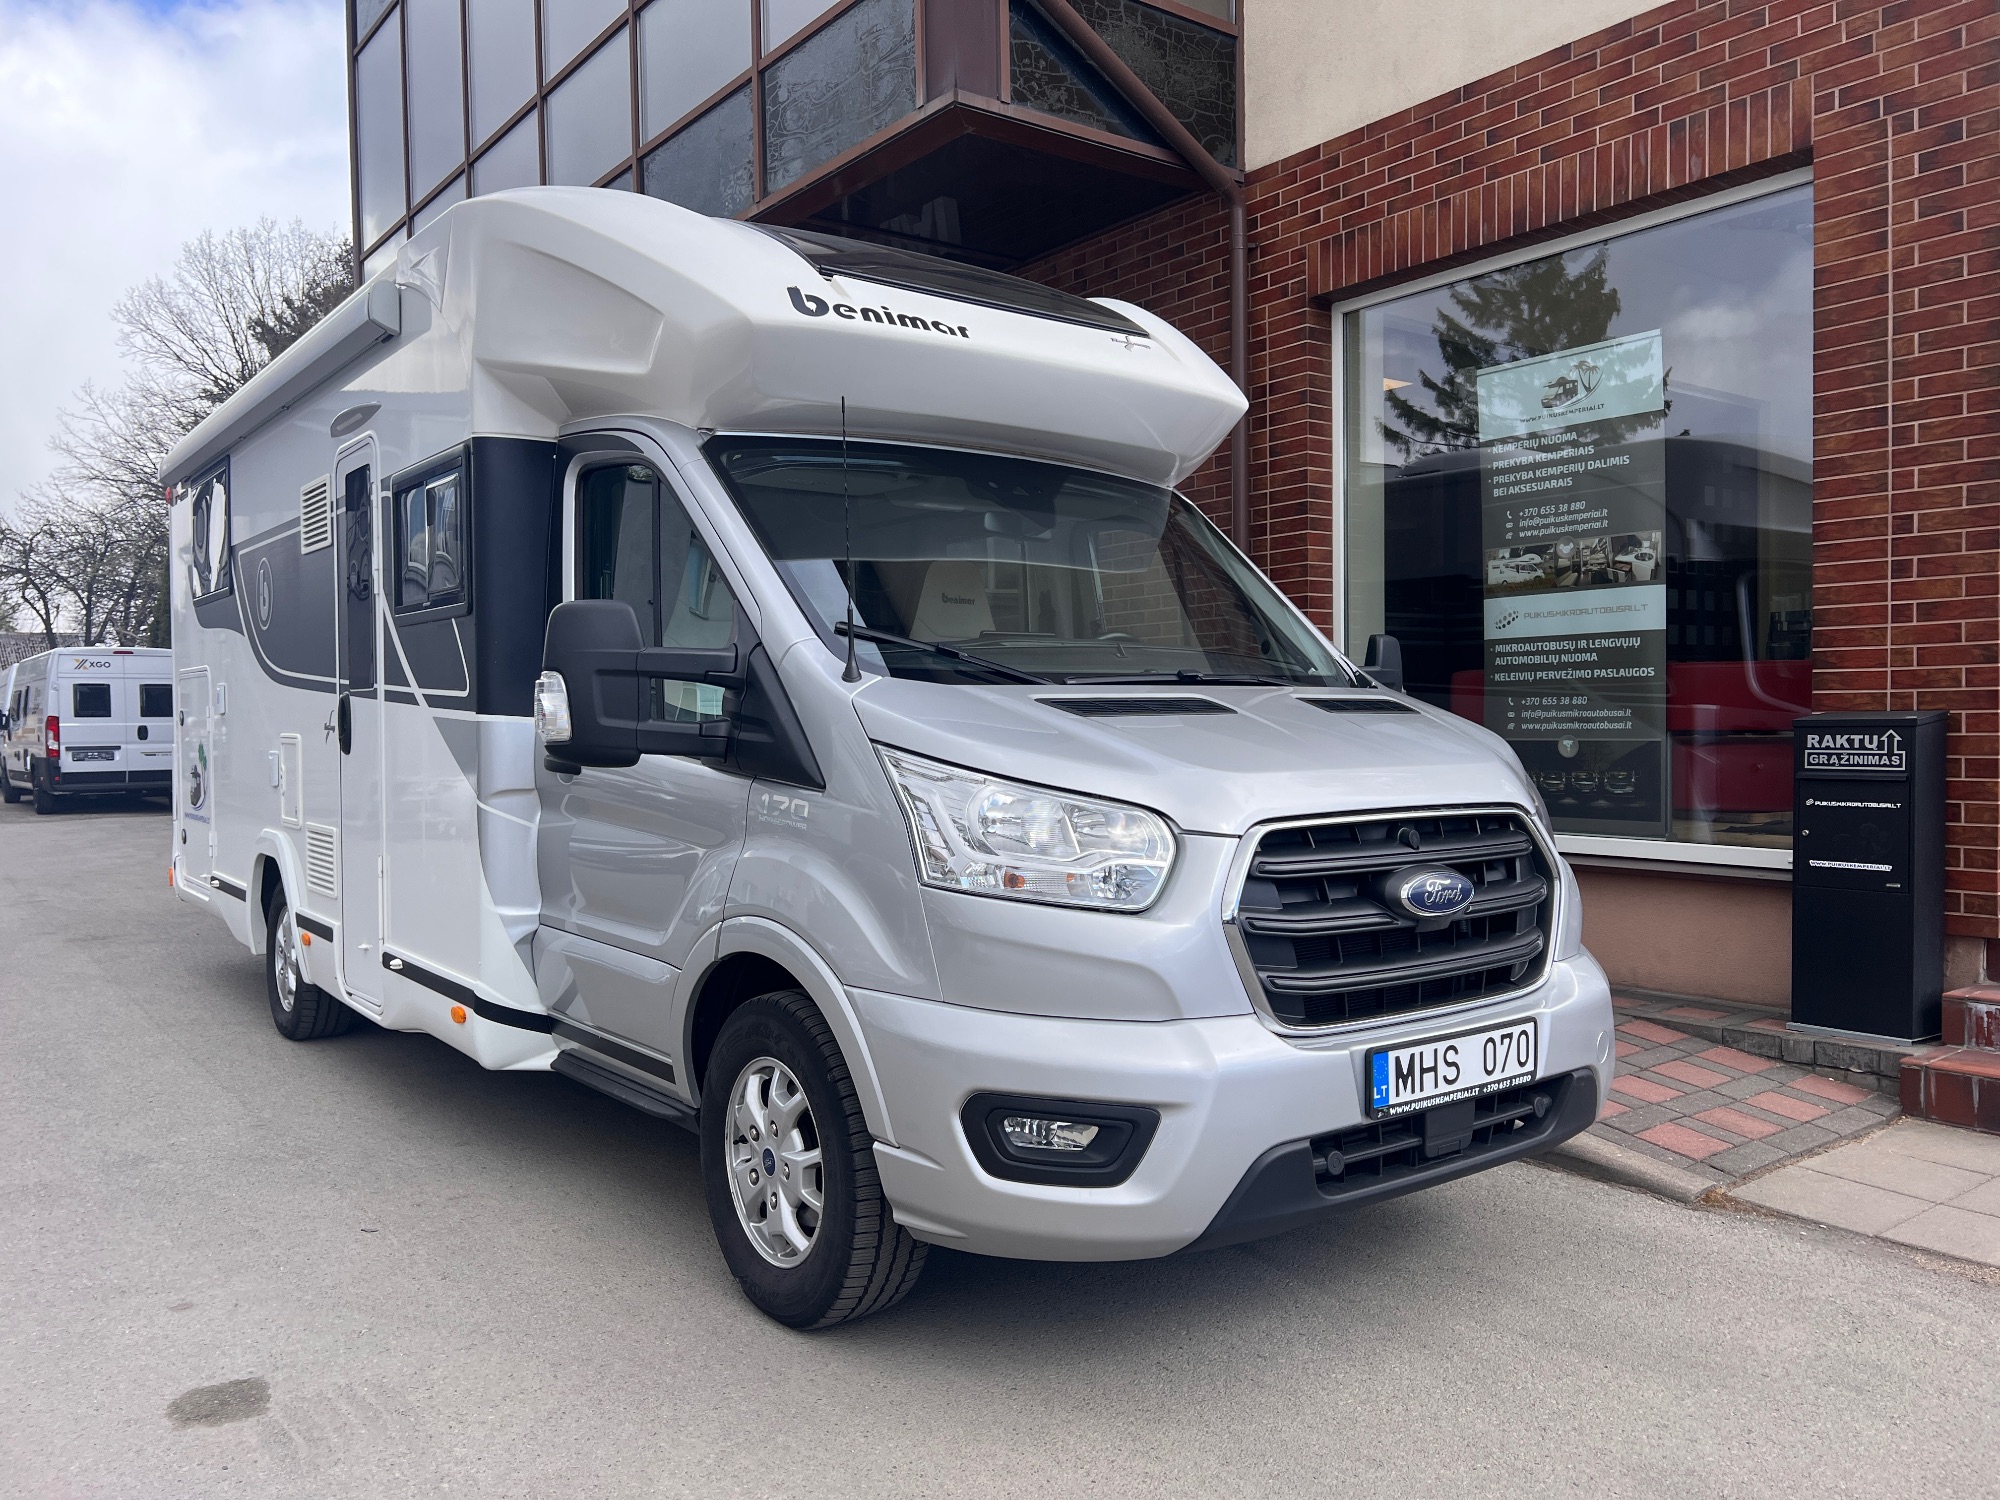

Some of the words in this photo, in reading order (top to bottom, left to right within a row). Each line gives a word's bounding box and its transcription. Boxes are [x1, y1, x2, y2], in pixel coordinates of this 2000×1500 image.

[787, 286, 970, 338] benimar
[1493, 439, 1539, 454] KEMPERIŲ
[1541, 432, 1577, 445] NUOMA
[1493, 456, 1534, 470] PREKYBA
[1536, 445, 1595, 463] KEMPERIAIS
[1493, 470, 1534, 484] PREKYBA
[1536, 463, 1584, 478] KEMPERIŲ
[1588, 455, 1630, 470] DALIMIS
[1493, 487, 1507, 497] BEI
[1508, 477, 1573, 495] AKSESUARAIS
[1519, 508, 1538, 517] +370
[1540, 505, 1555, 515] 655
[1558, 504, 1568, 512] 38
[1570, 501, 1586, 511] 880
[1519, 508, 1608, 528] info@puikuskemperiai.lt
[1519, 519, 1608, 537] www.puikuskemperiai.lt
[1495, 640, 1575, 653] MIKROAUTOBUSŲ
[1578, 640, 1587, 649] IR
[1590, 637, 1641, 649] LENGVŲJŲ
[1495, 654, 1559, 665] AUTOMOBILIŲ
[1561, 653, 1598, 663] NUOMA
[1495, 671, 1534, 682] KELEIVIŲ
[1536, 668, 1592, 680] PERVEŽIMO
[1594, 667, 1655, 678] PASLAUGOS
[1521, 697, 1540, 706] +370
[1542, 697, 1557, 705] 655
[1560, 696, 1570, 705] 38
[1572, 696, 1587, 705] 880
[1521, 709, 1632, 719] info@puikusmikroautobusai.lt
[1521, 721, 1632, 731] www.puikusmikroautobusai.lt
[1807, 734, 1879, 750] RAKTŲ
[1809, 752, 1900, 766] GRĄŽINIMAS
[762, 793, 809, 820] 170
[1424, 878, 1462, 905] Ford
[1373, 1085, 1388, 1099] LT
[1395, 1044, 1460, 1098] MHS
[1483, 1029, 1530, 1076] 070
[1389, 1087, 1480, 1116] WWW.PUIKUSKEMPERIAI.LT
[1482, 1083, 1498, 1094] +370
[1511, 1075, 1532, 1087] 38880
